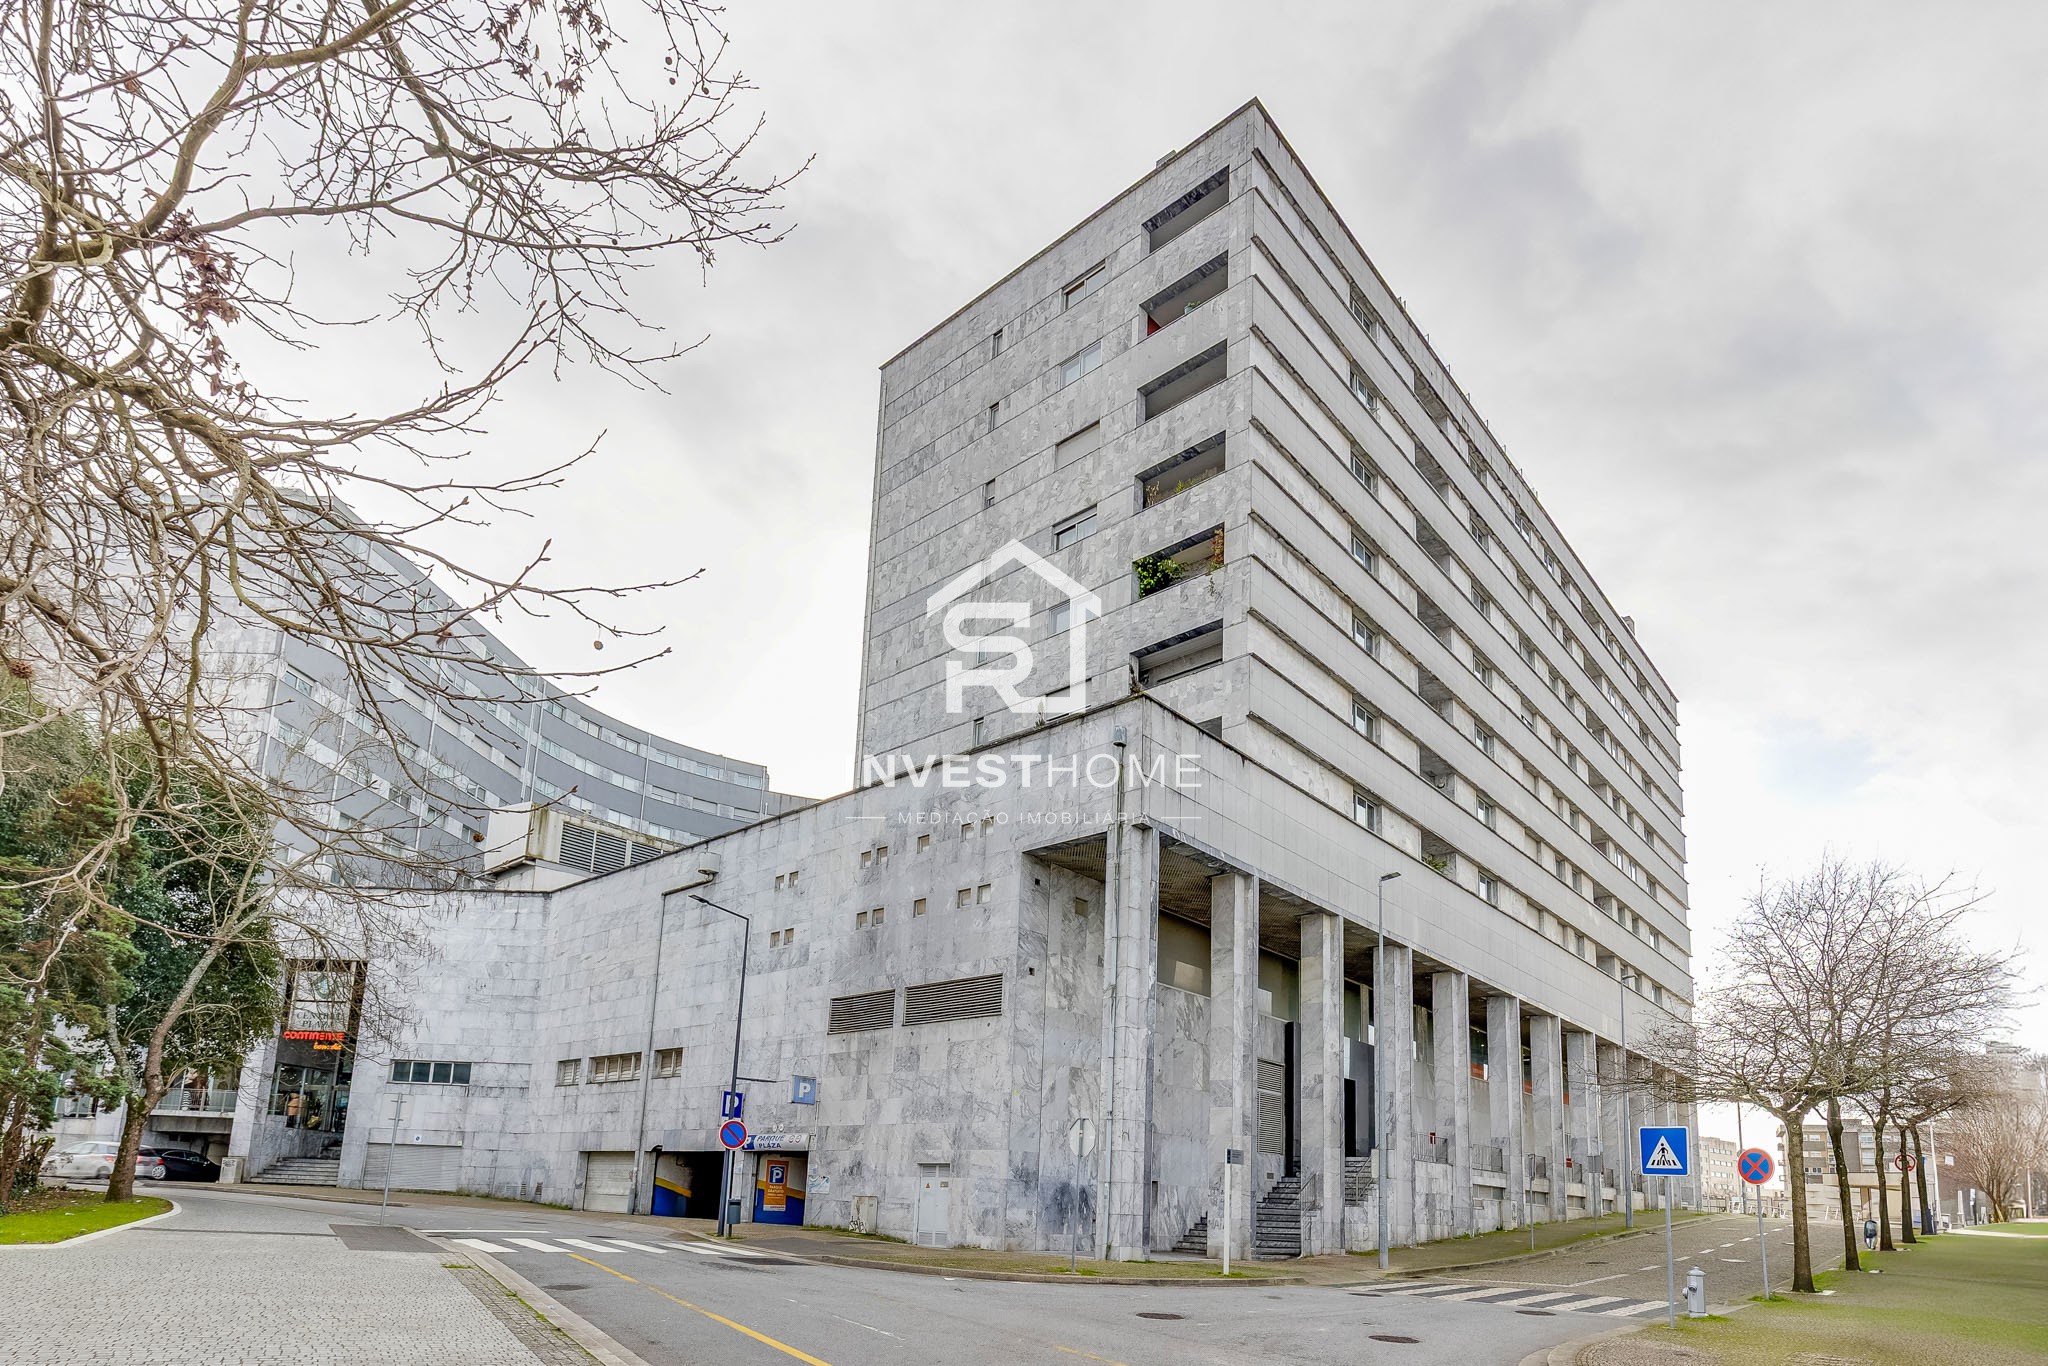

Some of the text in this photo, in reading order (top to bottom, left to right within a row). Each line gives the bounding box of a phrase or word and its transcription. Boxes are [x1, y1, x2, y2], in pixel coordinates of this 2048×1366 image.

[799, 1083, 811, 1098] P
[725, 1094, 739, 1115] P
[773, 1170, 782, 1182] P
